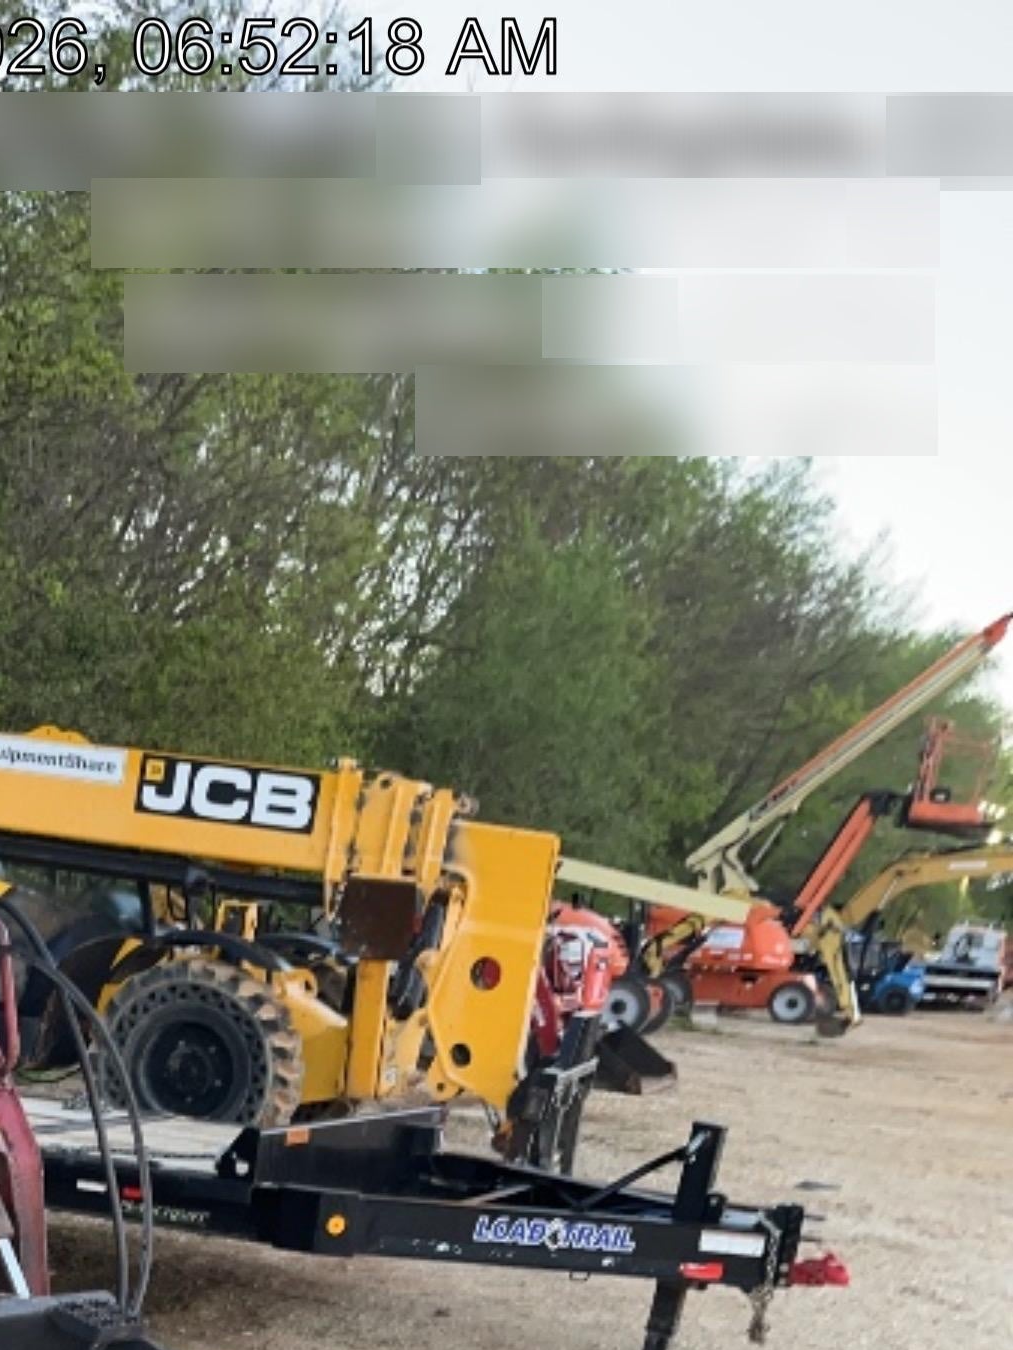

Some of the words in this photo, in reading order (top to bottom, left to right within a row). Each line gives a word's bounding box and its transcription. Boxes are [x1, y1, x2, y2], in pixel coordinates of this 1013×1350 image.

[141, 761, 315, 830] JCB
[473, 1214, 548, 1246] LOAD
[559, 1220, 636, 1252] TRAIL
